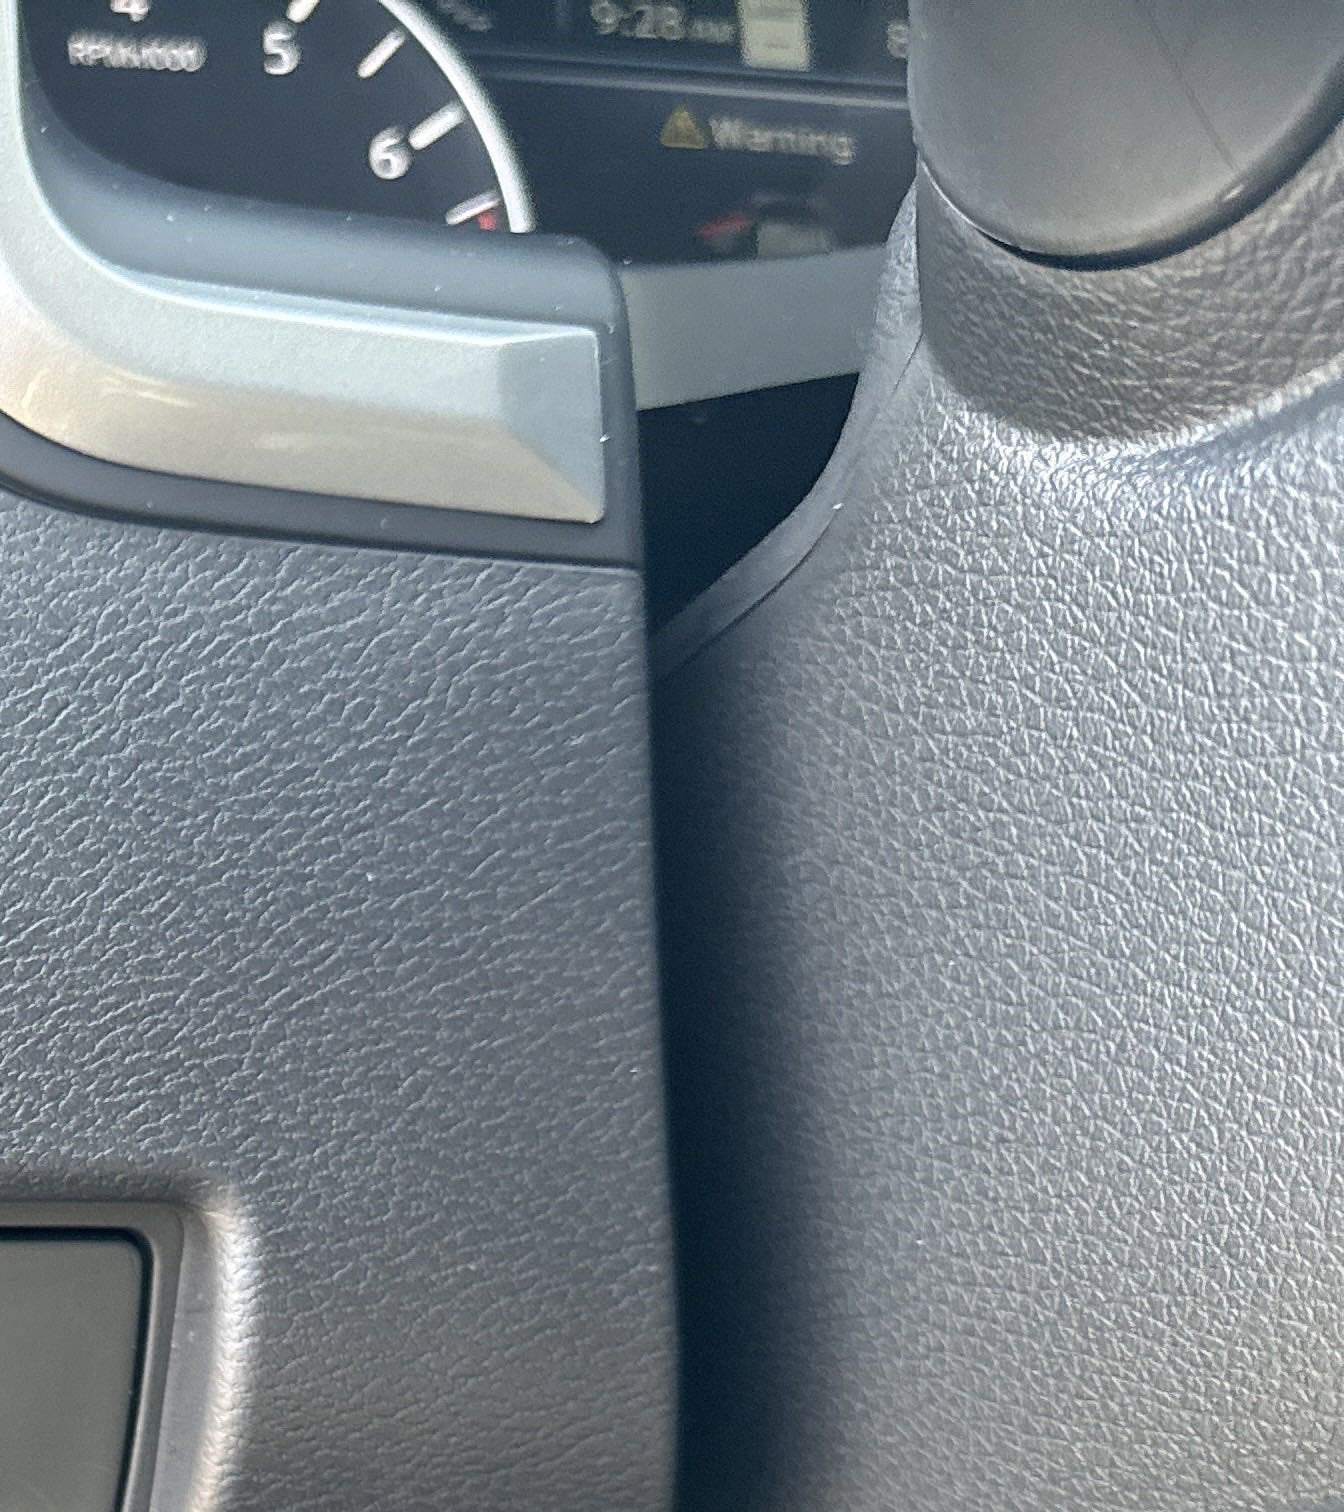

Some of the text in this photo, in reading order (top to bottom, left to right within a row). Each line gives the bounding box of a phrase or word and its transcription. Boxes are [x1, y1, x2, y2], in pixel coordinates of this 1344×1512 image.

[261, 18, 302, 77] 5
[368, 123, 415, 181] 6
[709, 116, 857, 166] Warning
